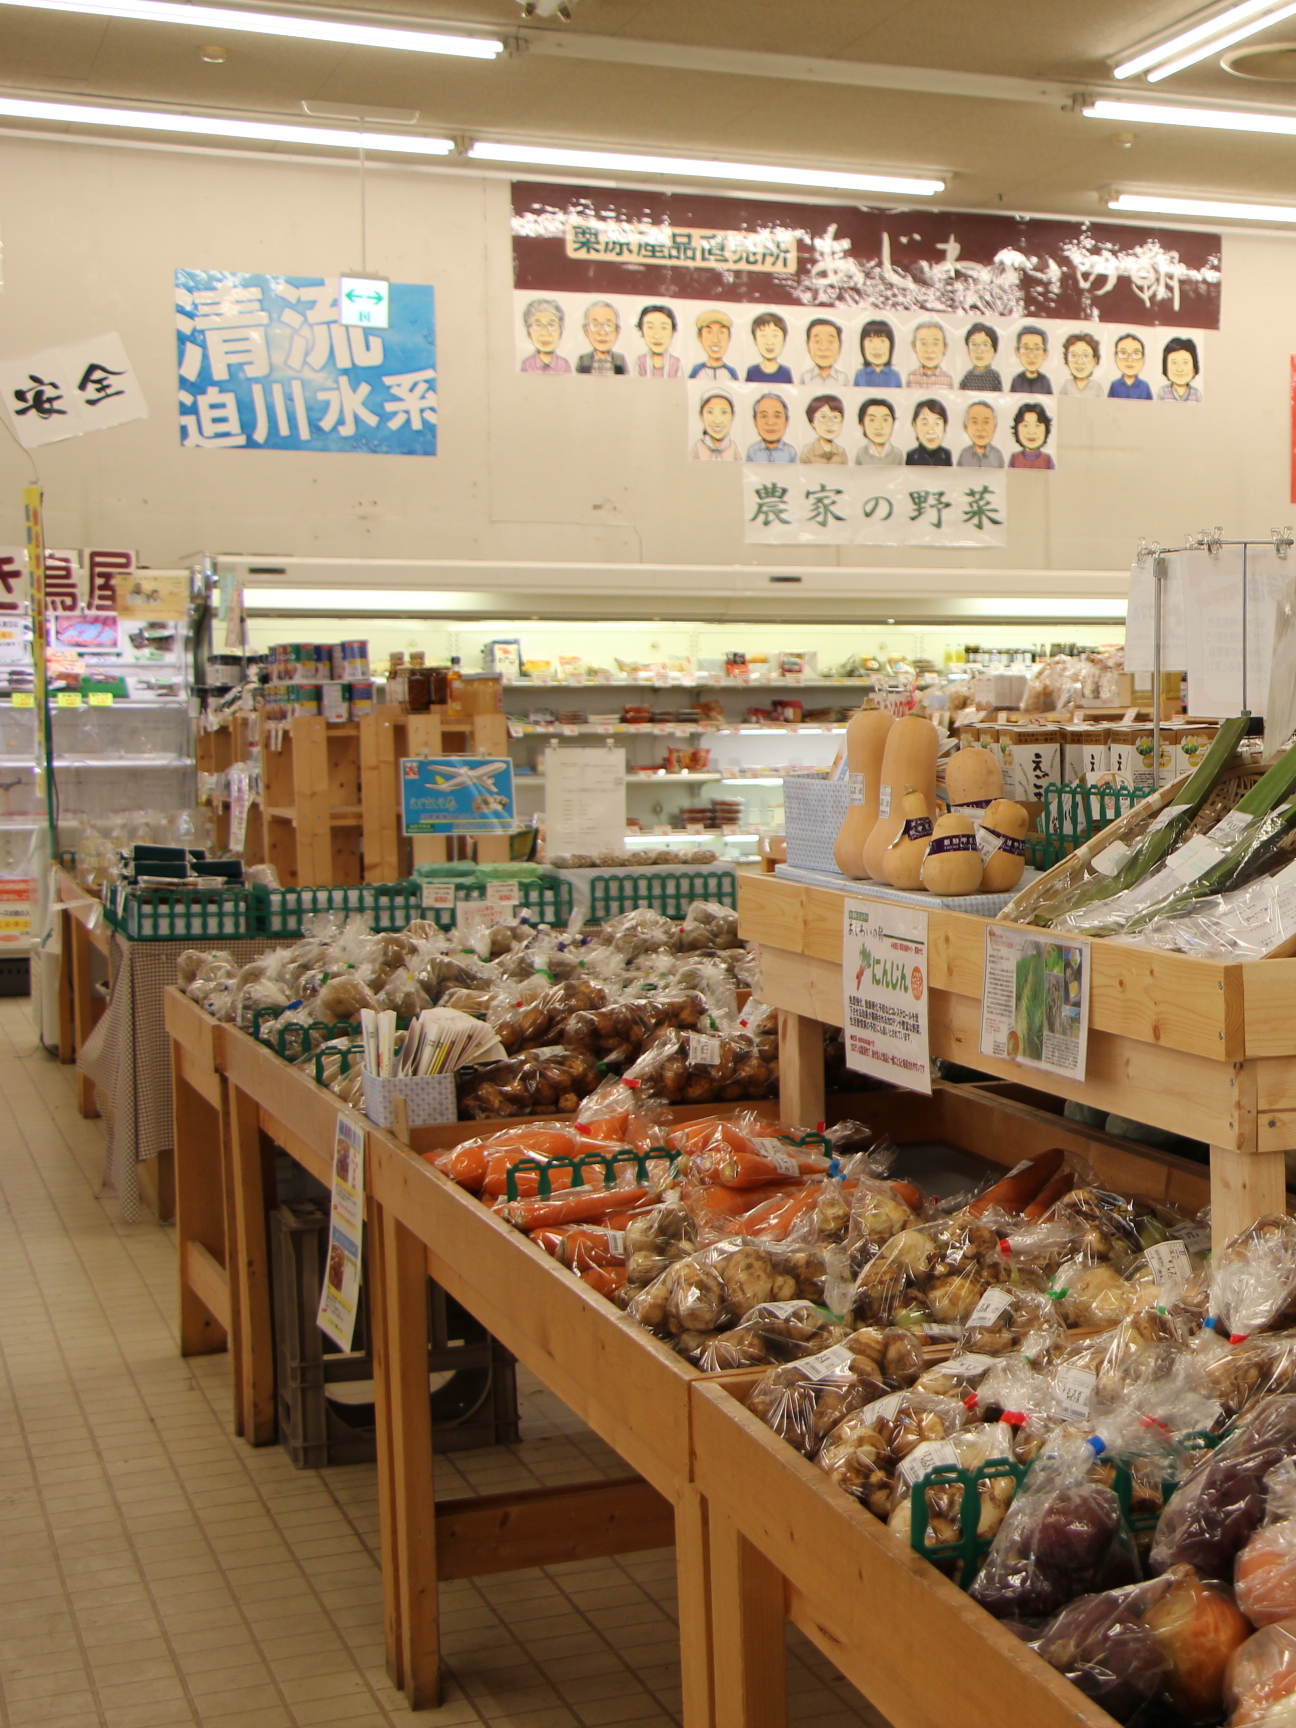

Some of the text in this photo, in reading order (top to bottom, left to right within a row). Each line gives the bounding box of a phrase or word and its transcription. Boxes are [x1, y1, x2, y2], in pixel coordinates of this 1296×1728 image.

[177, 279, 384, 381] 清流
[12, 361, 129, 421] 安全
[179, 369, 437, 449] 迫川水系
[749, 482, 1005, 531] 農家の野菜
[871, 956, 909, 994] にんじん
